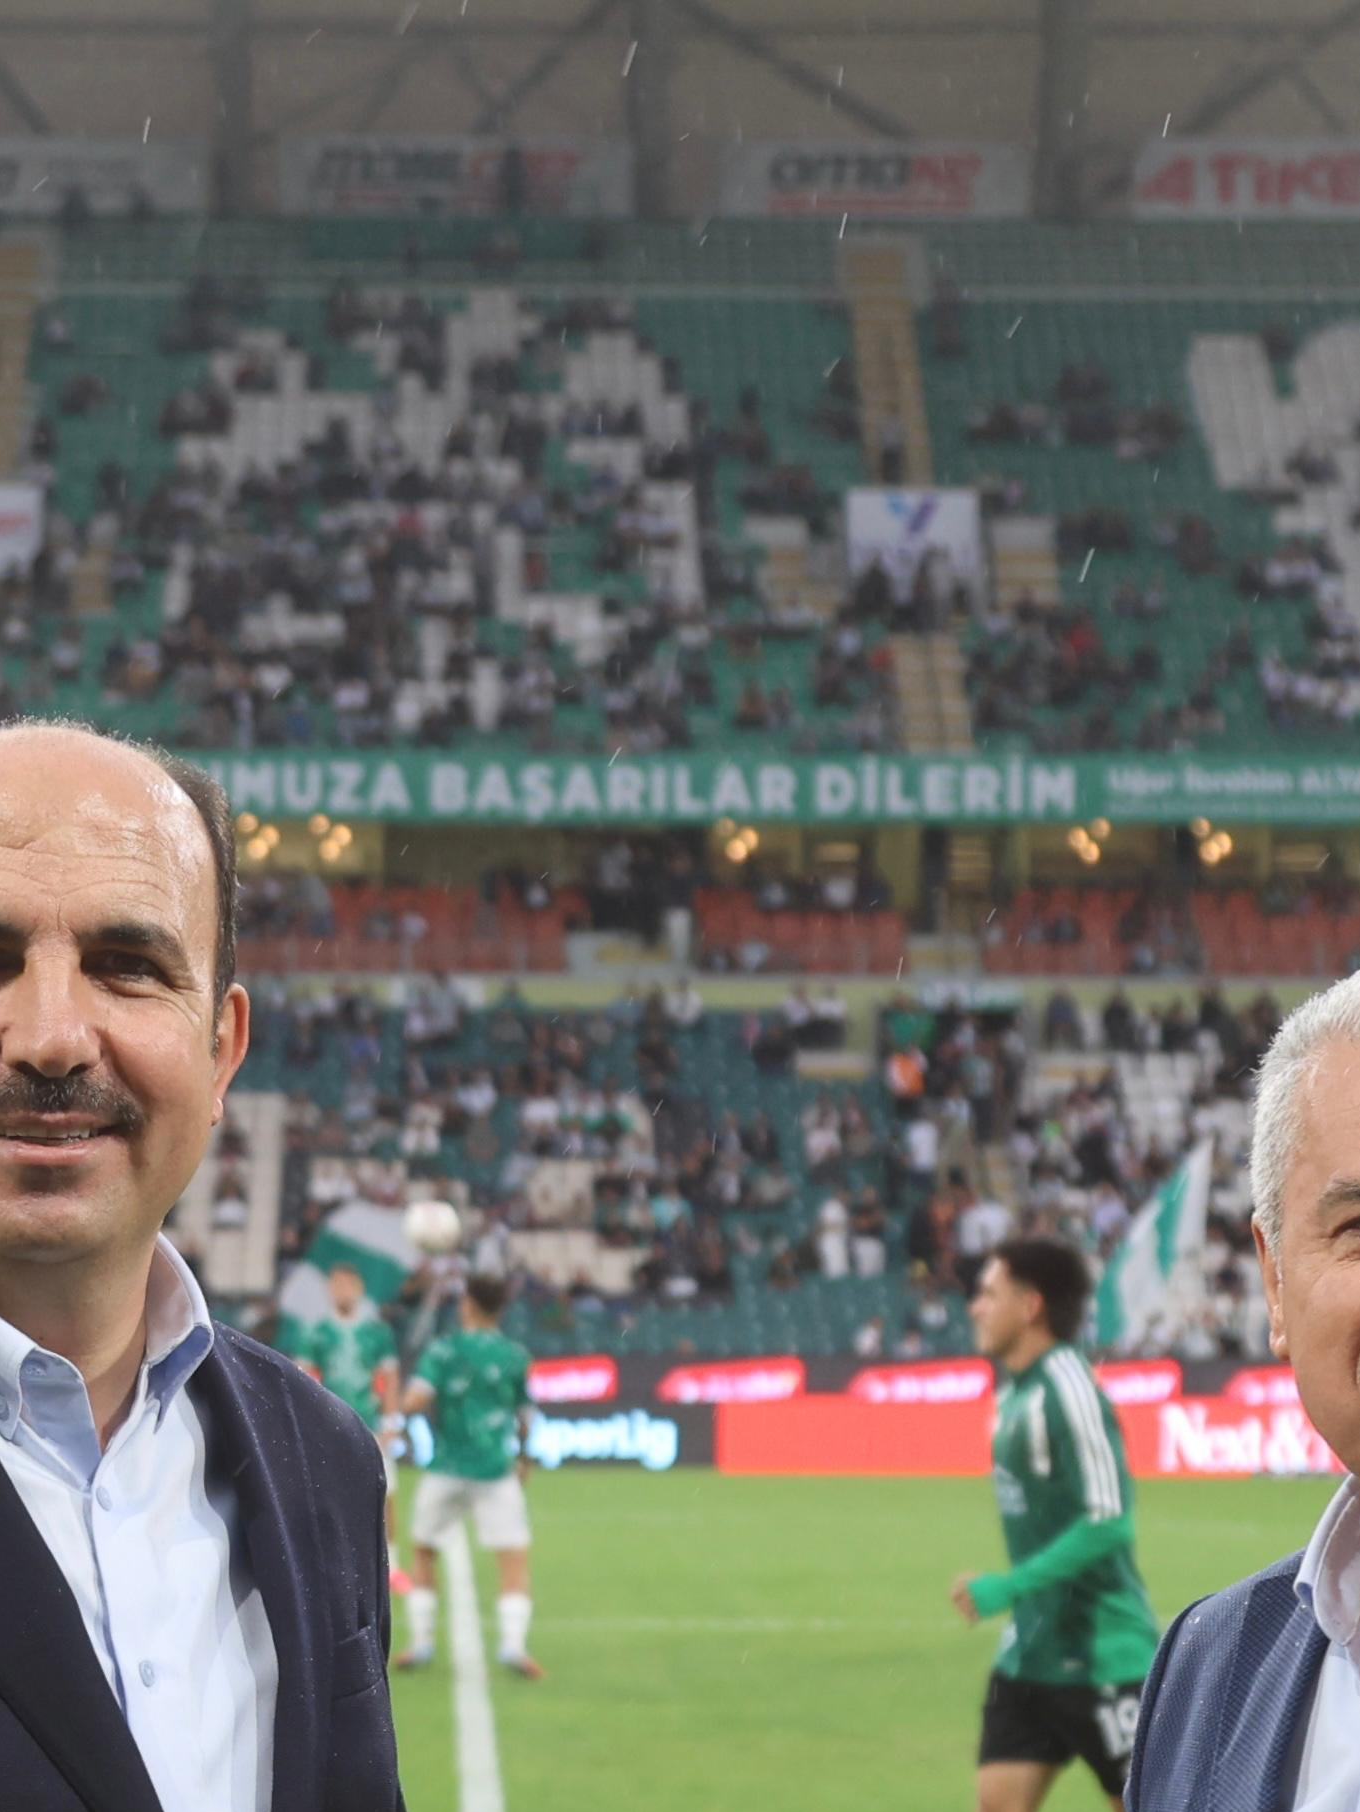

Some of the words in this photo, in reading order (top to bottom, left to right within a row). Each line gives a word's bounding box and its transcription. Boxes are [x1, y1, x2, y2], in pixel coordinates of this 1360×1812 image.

[209, 762, 411, 812] MUZA
[427, 763, 798, 821] BAŞARILAR
[815, 757, 1076, 816] DİLERİM
